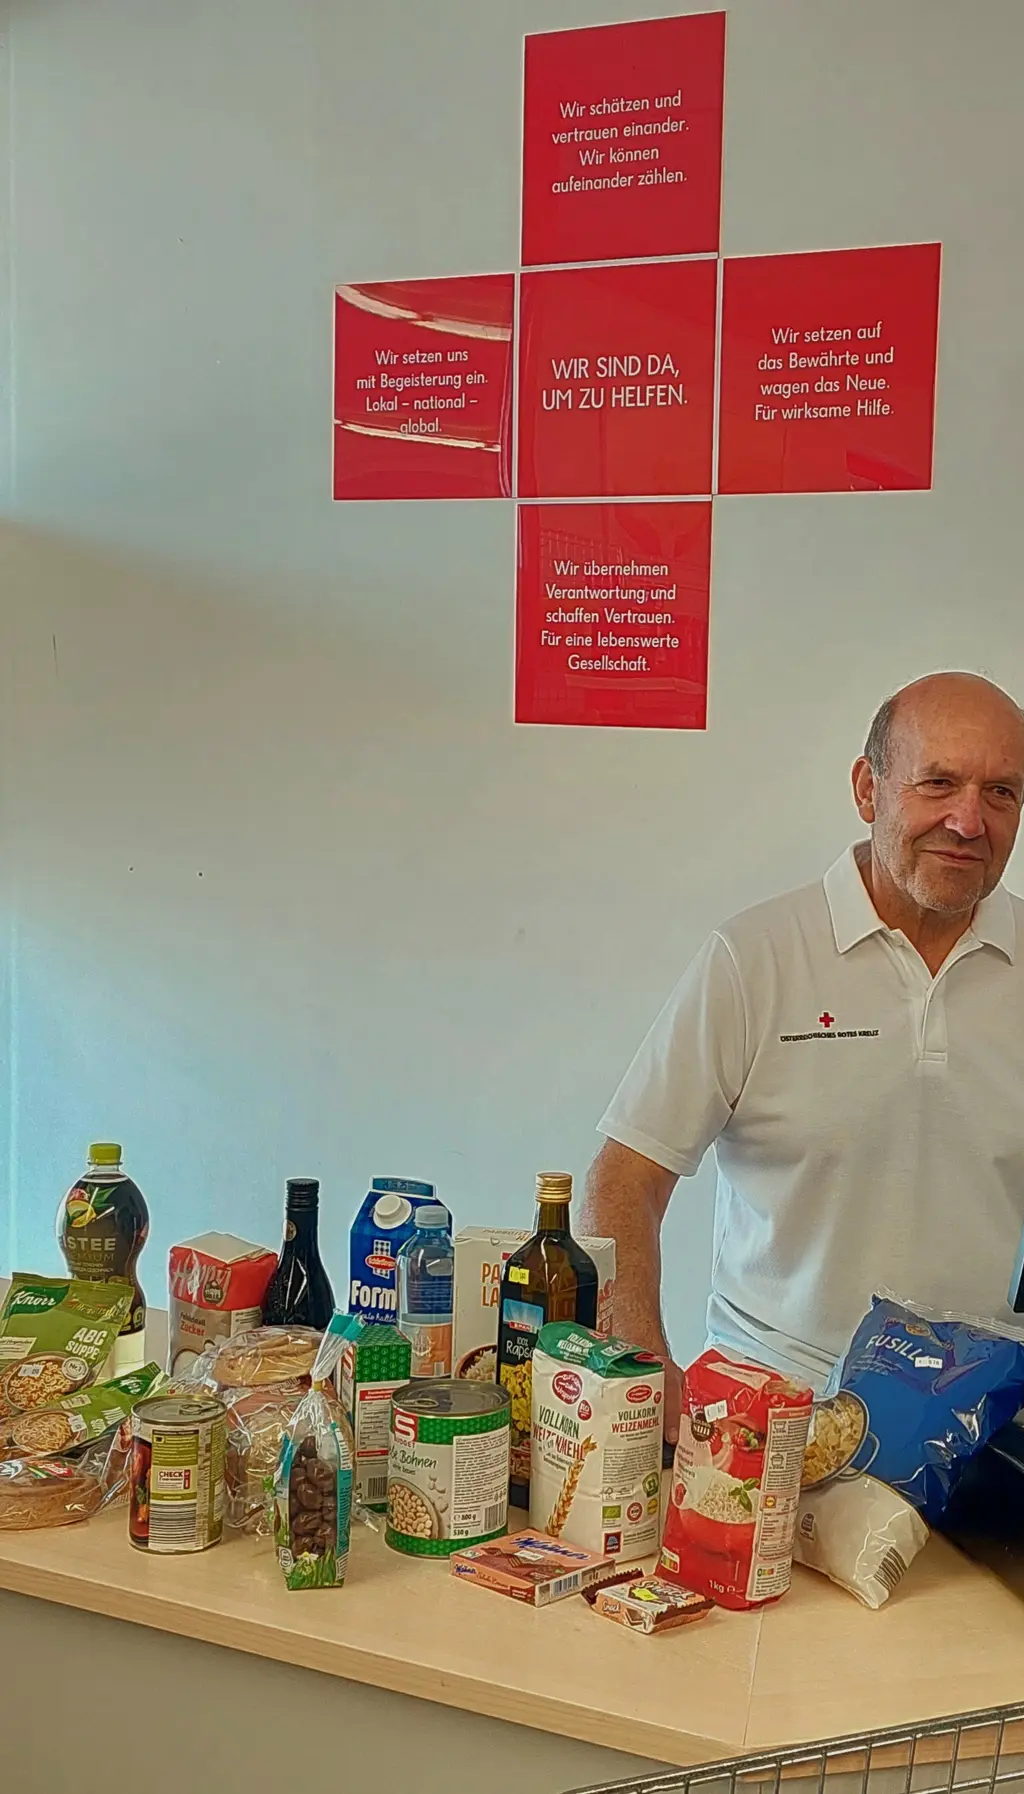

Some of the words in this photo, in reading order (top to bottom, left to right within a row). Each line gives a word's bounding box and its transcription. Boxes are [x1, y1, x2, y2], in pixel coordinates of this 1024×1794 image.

[559, 101, 586, 119] Wir
[589, 97, 650, 116] schätzen
[655, 89, 682, 108] und
[551, 127, 618, 144] vertrauen
[623, 115, 690, 137] einander.
[578, 148, 605, 167] Wir
[609, 147, 659, 164] können
[551, 171, 634, 193] aufeinander
[637, 166, 688, 186] zählen.
[771, 327, 800, 344] Wir
[804, 326, 852, 343] setzen
[856, 320, 883, 339] auf
[374, 349, 399, 366] Wir
[402, 349, 442, 365] setzen
[447, 350, 469, 363] uns
[551, 357, 590, 380] WIR
[595, 355, 642, 378] SIND
[647, 352, 680, 379] DA,
[758, 352, 783, 370] das
[789, 349, 860, 369] Bewährte
[865, 346, 895, 365] und
[356, 375, 376, 390] mit
[380, 372, 462, 392] Begeisterung
[466, 370, 489, 386] ein.
[760, 381, 809, 399] wagen
[814, 375, 840, 393] das
[846, 373, 891, 392] Neue.
[366, 395, 398, 412] Lokal
[413, 392, 466, 411] national
[542, 387, 573, 410] UM
[578, 386, 605, 409] ZU
[611, 383, 688, 408] HELFEN.
[755, 404, 778, 421] Für
[781, 401, 851, 420] wirksame
[857, 398, 895, 416] Hilfe.
[400, 416, 442, 436] global.
[553, 560, 580, 576] Wir
[583, 559, 669, 576] übernehmen
[545, 583, 645, 604] Verantwortung
[650, 583, 677, 600] und
[546, 607, 599, 623] schaffen
[603, 607, 676, 624] Vertrauen.
[541, 630, 562, 647] Für
[565, 632, 593, 647] eine
[597, 631, 680, 649] lebenswerte
[568, 653, 651, 672] Gesellschaft.
[837, 1030, 858, 1038] ROTES
[858, 1029, 879, 1037] KREUZ
[482, 1262, 500, 1284] PA
[12, 1290, 57, 1306] Knorr
[351, 1280, 397, 1311] Form
[482, 1286, 499, 1307] LA
[72, 1327, 108, 1346] ABC
[65, 1340, 101, 1360] SUPPE
[539, 1405, 579, 1440] VOLLKORN
[618, 1406, 657, 1421] VOLLKORN
[611, 1417, 660, 1434] WEIZENMEHL
[400, 1449, 438, 1470] Bohnen
